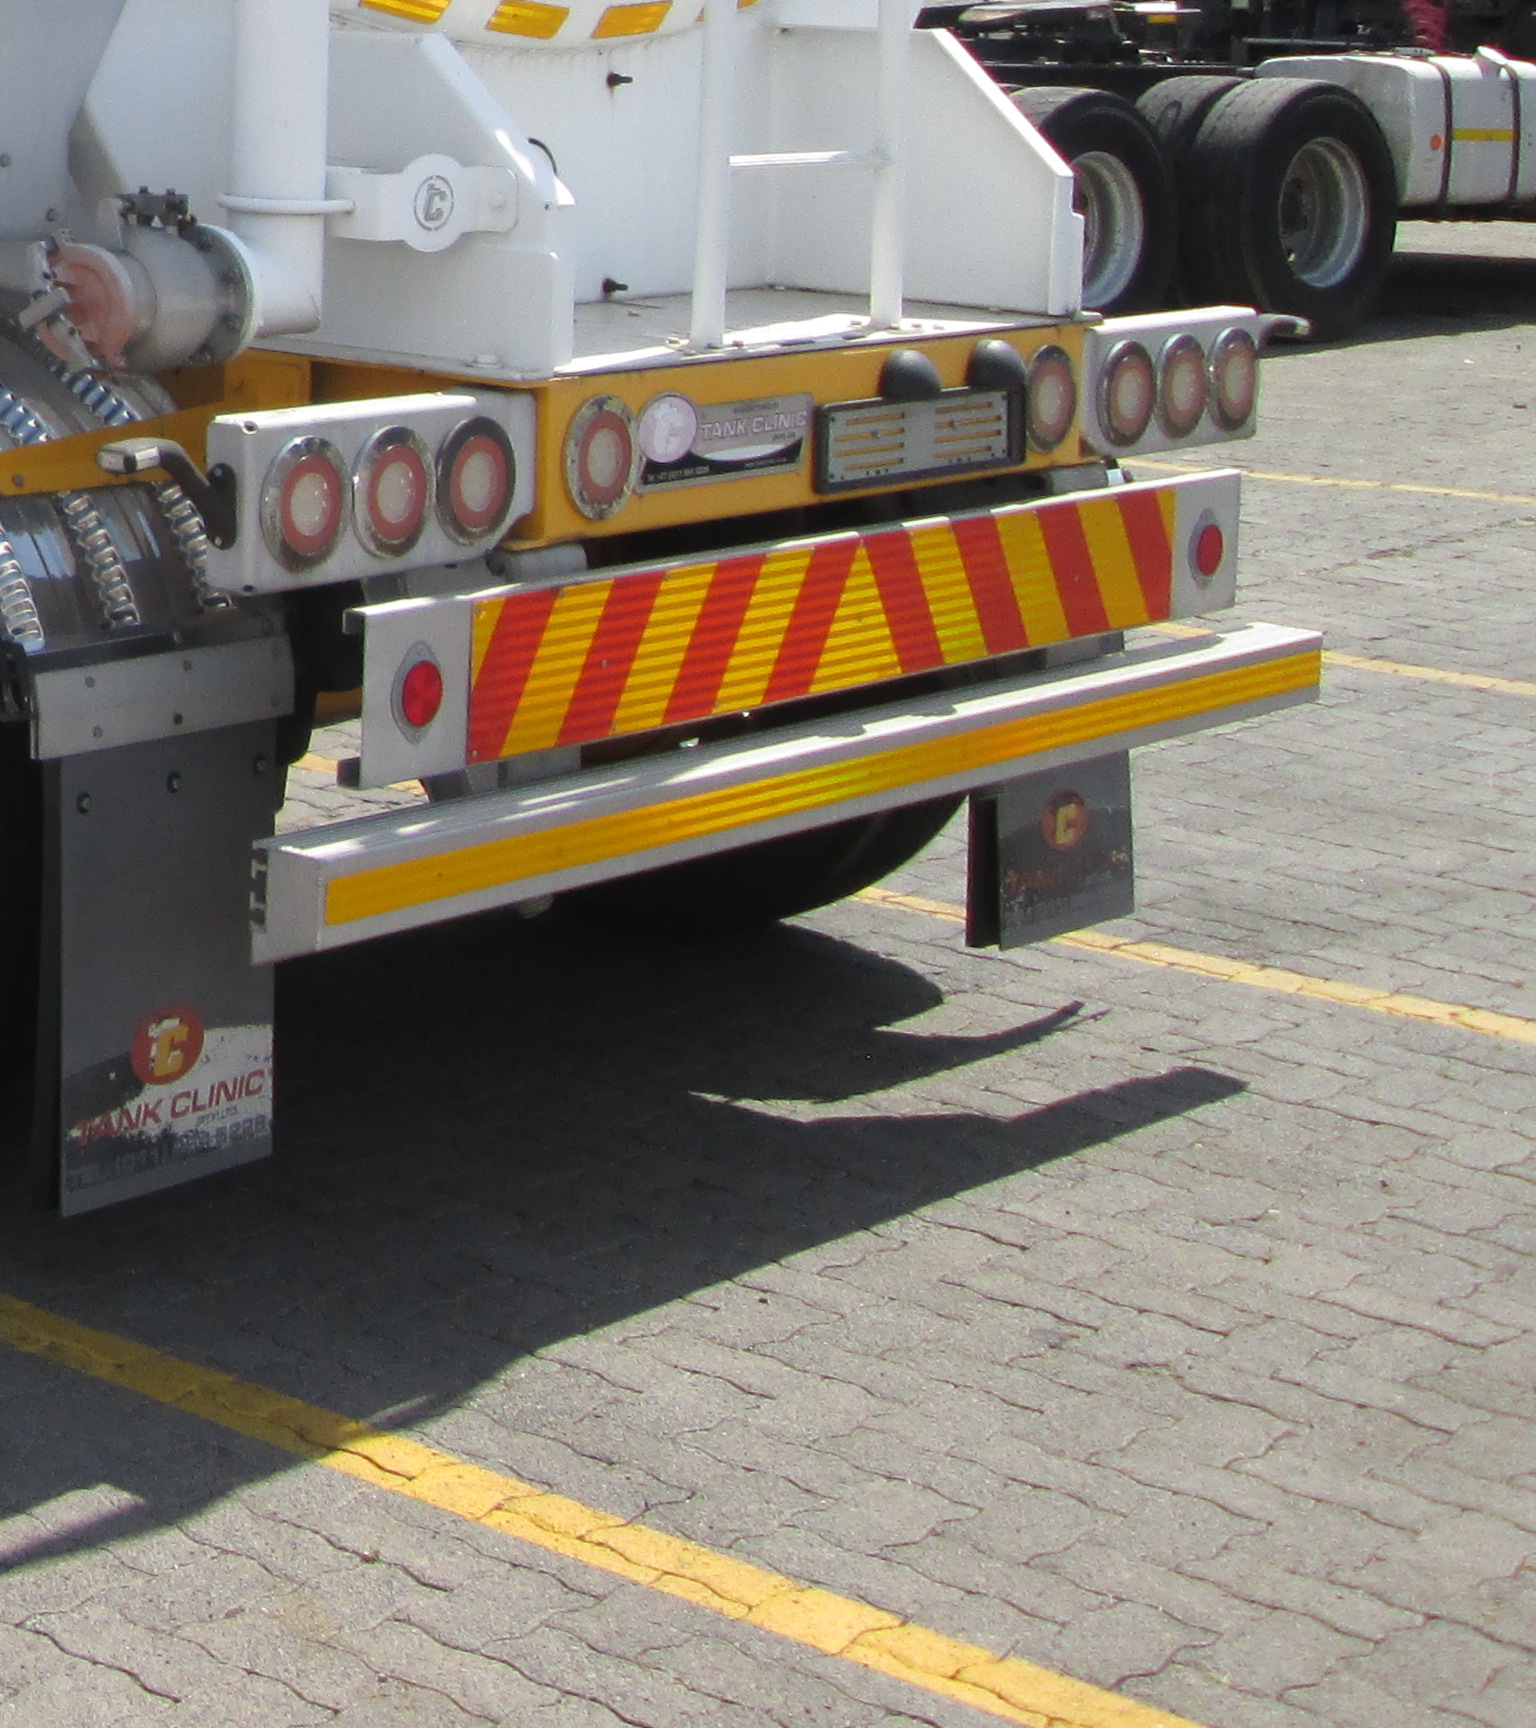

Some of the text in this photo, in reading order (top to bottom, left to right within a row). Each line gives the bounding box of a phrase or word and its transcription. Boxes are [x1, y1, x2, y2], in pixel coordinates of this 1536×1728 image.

[701, 410, 807, 439] TANK CLINIC
[78, 1098, 165, 1146] TANK
[170, 1069, 265, 1119] CLINIC
